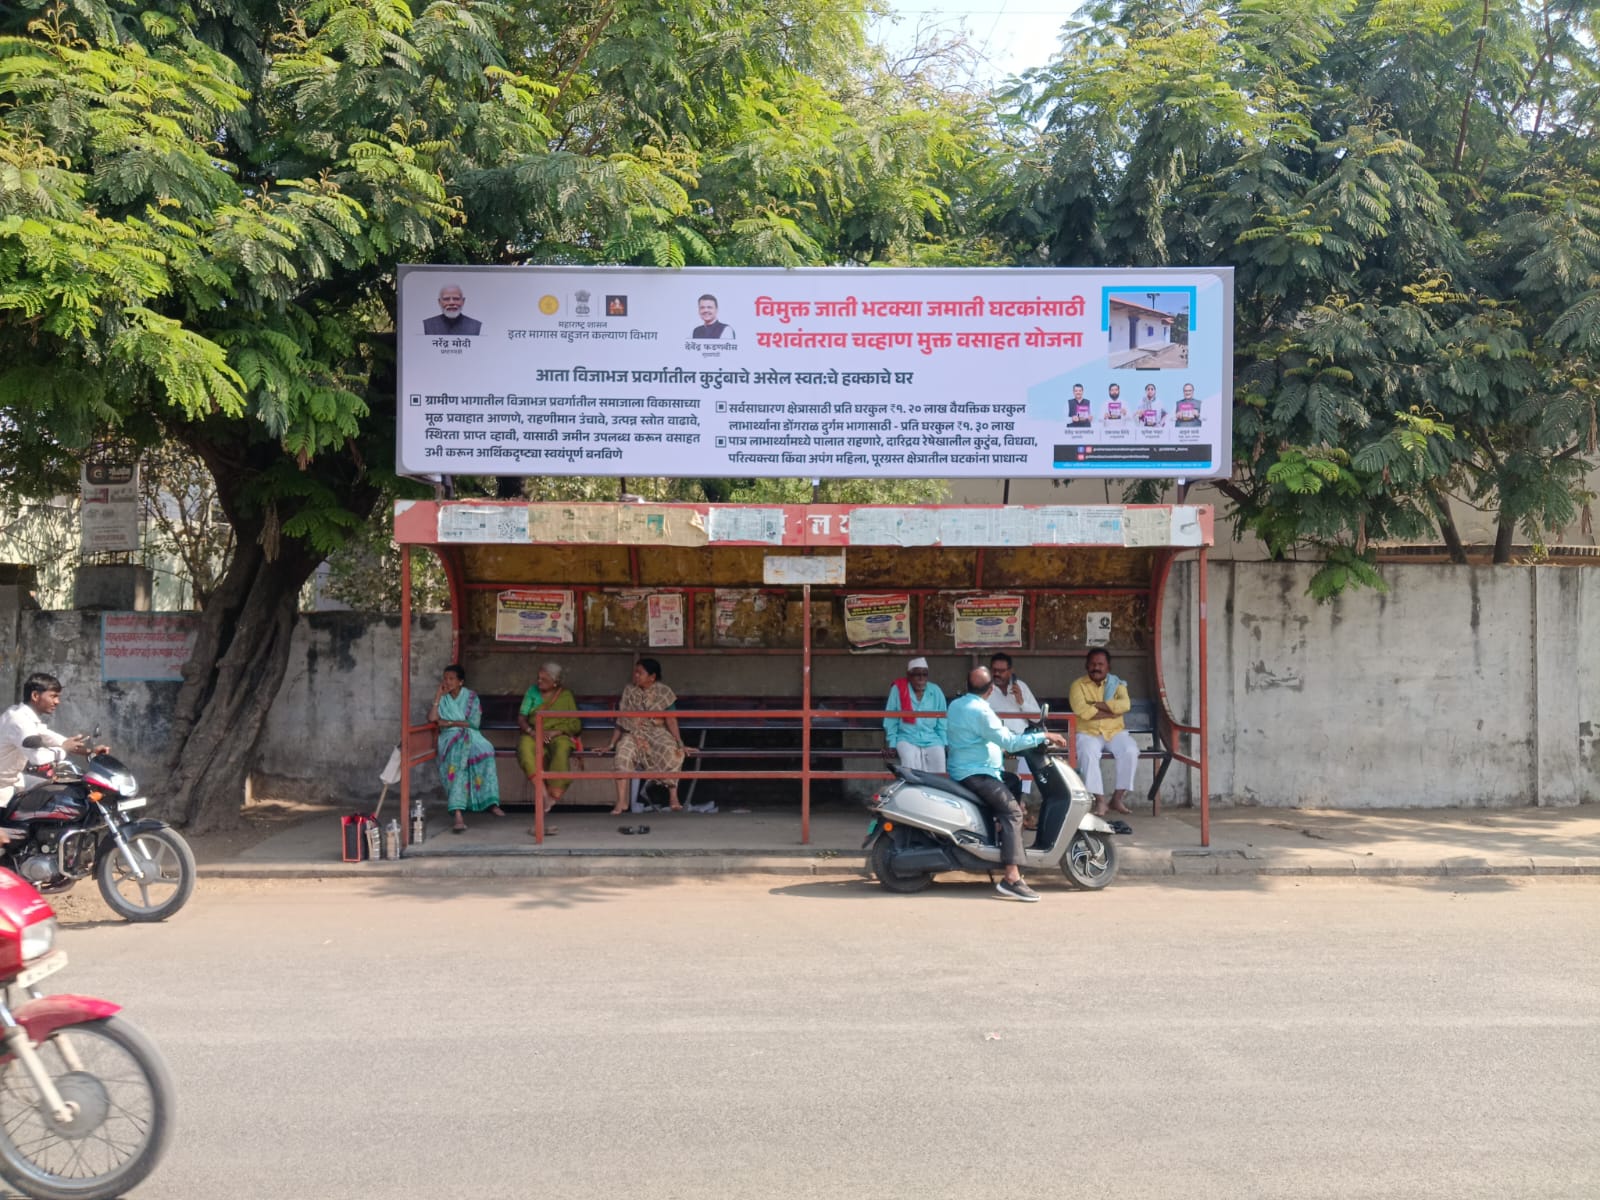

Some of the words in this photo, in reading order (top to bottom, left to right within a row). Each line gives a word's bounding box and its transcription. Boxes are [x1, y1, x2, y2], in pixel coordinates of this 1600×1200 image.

[754, 296, 811, 324] विमुक्त
[814, 296, 858, 317] जाती
[861, 301, 923, 317] भटक्या
[927, 296, 985, 317] जमाती
[988, 295, 1086, 317] घटकांसाठी
[586, 321, 608, 329] शासन
[451, 337, 471, 349] मोदी
[507, 329, 526, 340] इतर
[529, 330, 558, 340] मागास
[560, 331, 590, 343] बहुजन
[591, 331, 628, 341] कल्याण
[630, 329, 659, 341] विभाग
[756, 328, 848, 348] यशवंतराव
[851, 332, 913, 350] चव्हाण
[917, 332, 953, 355] मुक्त
[956, 332, 1021, 350] वसाहत
[1024, 327, 1083, 348] योजना
[536, 369, 570, 383] आता
[573, 366, 629, 383] विजाभज
[632, 367, 697, 384] प्रवर्गातील
[699, 368, 751, 390] कुटुंबाचे
[754, 368, 792, 385] असेल
[842, 368, 892, 386] हक्काचे
[894, 371, 914, 385] घर
[425, 393, 459, 406] ग्रामीण
[461, 393, 505, 406] भागातील
[507, 394, 547, 407] विजाभज
[549, 394, 597, 408] प्रवर्गातील
[598, 398, 645, 408] समाजाला
[647, 396, 701, 409] विकासाच्या
[728, 401, 785, 414] सर्वसाधारण
[787, 401, 831, 414] क्षेत्रासाठी
[833, 402, 852, 414] प्रति
[855, 404, 888, 417] घरकुल
[924, 404, 947, 414] लाख
[949, 401, 990, 414] वैयक्तिक
[993, 404, 1026, 417] घरकुल
[425, 413, 444, 426] मूळ
[446, 413, 484, 425] प्रवाहात
[487, 411, 525, 425] आणणे,
[527, 411, 576, 425] राहणीमान
[611, 415, 638, 426] उत्पन्न
[783, 418, 819, 431] डोंगराळ
[821, 419, 845, 435] दुर्गम
[846, 419, 892, 431] भागासाठी
[900, 419, 919, 431] प्रति
[921, 422, 955, 435] घरकुल
[991, 422, 1015, 431] लाख
[425, 428, 460, 440] स्थिरता
[463, 430, 487, 441] प्राप्त
[523, 429, 559, 441] यासाठी
[561, 430, 590, 442] जमीन
[633, 432, 663, 443] करून
[665, 433, 701, 444] वसाहत
[728, 436, 747, 446] पात्र
[813, 437, 844, 447] पालात
[846, 434, 884, 448] राहणारे,
[922, 434, 971, 447] रेषेखालील
[1003, 435, 1038, 448] विधवा,
[425, 445, 443, 457] उभी
[445, 448, 474, 457] करून
[544, 447, 583, 462] स्वयंपूर्ण
[781, 452, 806, 464] किंवा
[808, 452, 833, 464] अपंग
[835, 452, 870, 465] महिला,
[871, 454, 905, 467] पूरग्रस्त
[906, 452, 948, 464] क्षेत्रातील
[950, 452, 990, 464] घटकांना
[992, 453, 1028, 464] प्राधान्य
